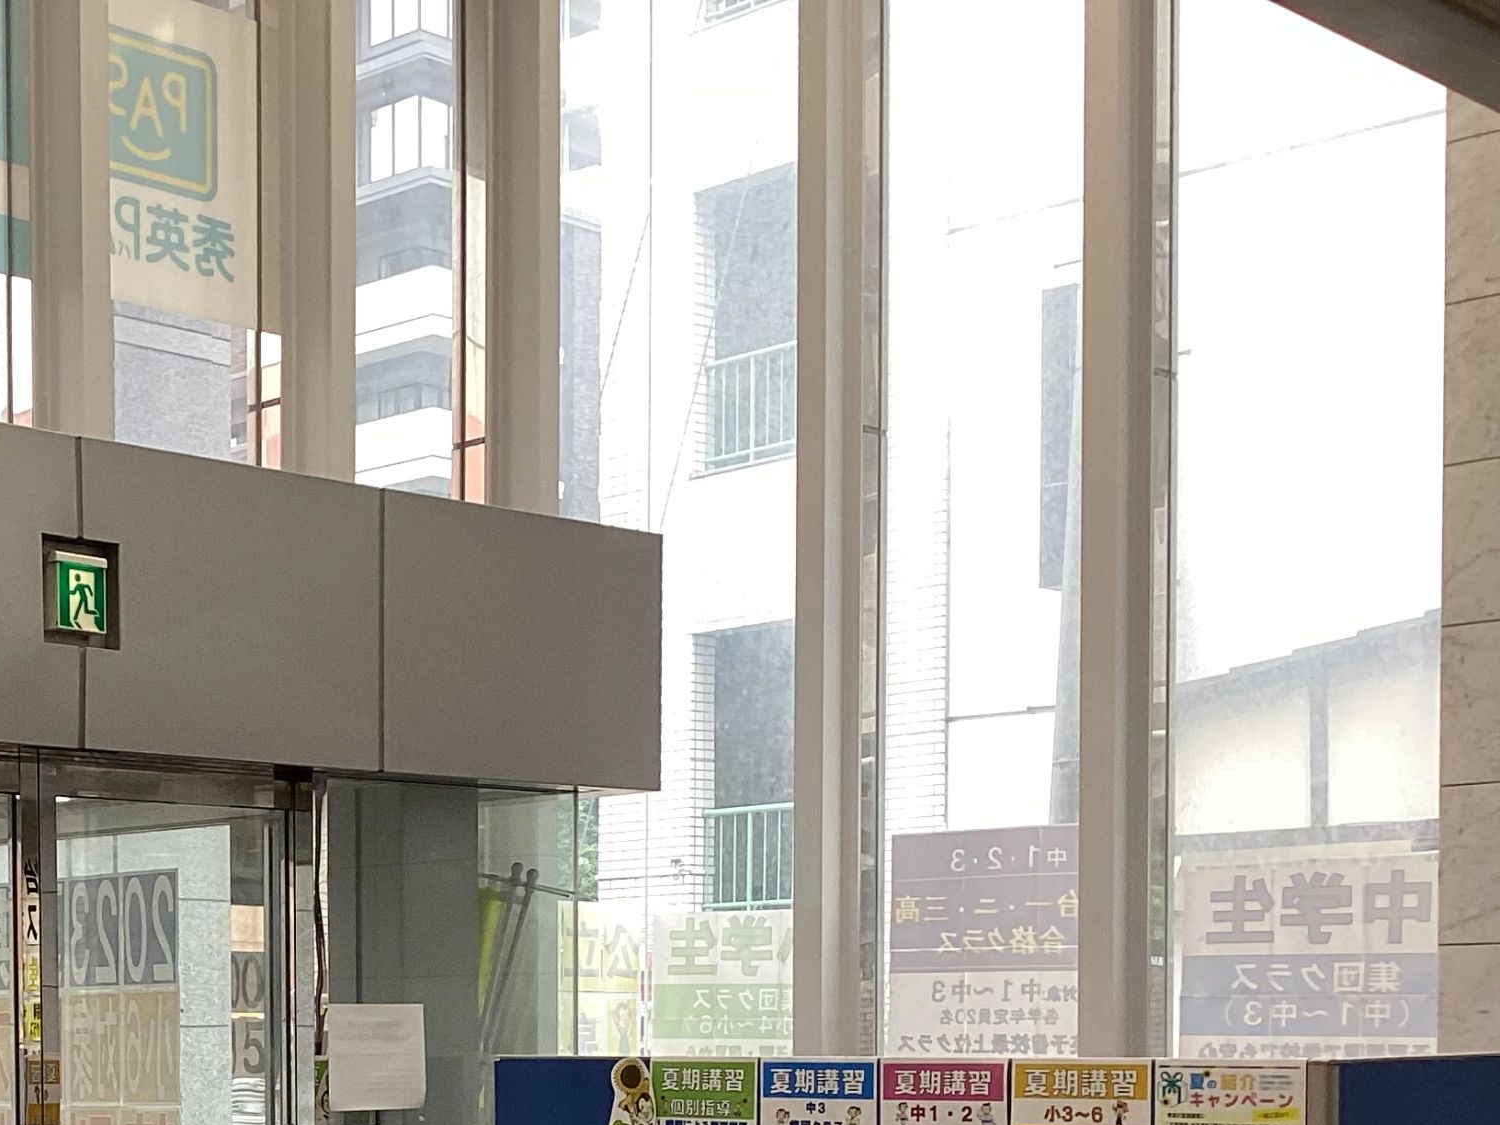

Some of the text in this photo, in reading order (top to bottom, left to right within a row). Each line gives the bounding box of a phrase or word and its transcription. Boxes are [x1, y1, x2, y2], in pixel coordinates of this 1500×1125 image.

[660, 1067, 745, 1092] 夏期講習
[770, 1068, 865, 1095] 夏期講習
[894, 1069, 991, 1096] 夏期講習
[1024, 1069, 1138, 1098] 夏期講習
[670, 1098, 732, 1117] 個別指導
[805, 1102, 827, 1115] 中3
[1189, 1092, 1294, 1108] キャンペーン
[910, 1104, 973, 1123] 中1・2
[1043, 1105, 1104, 1123] 小3～6
